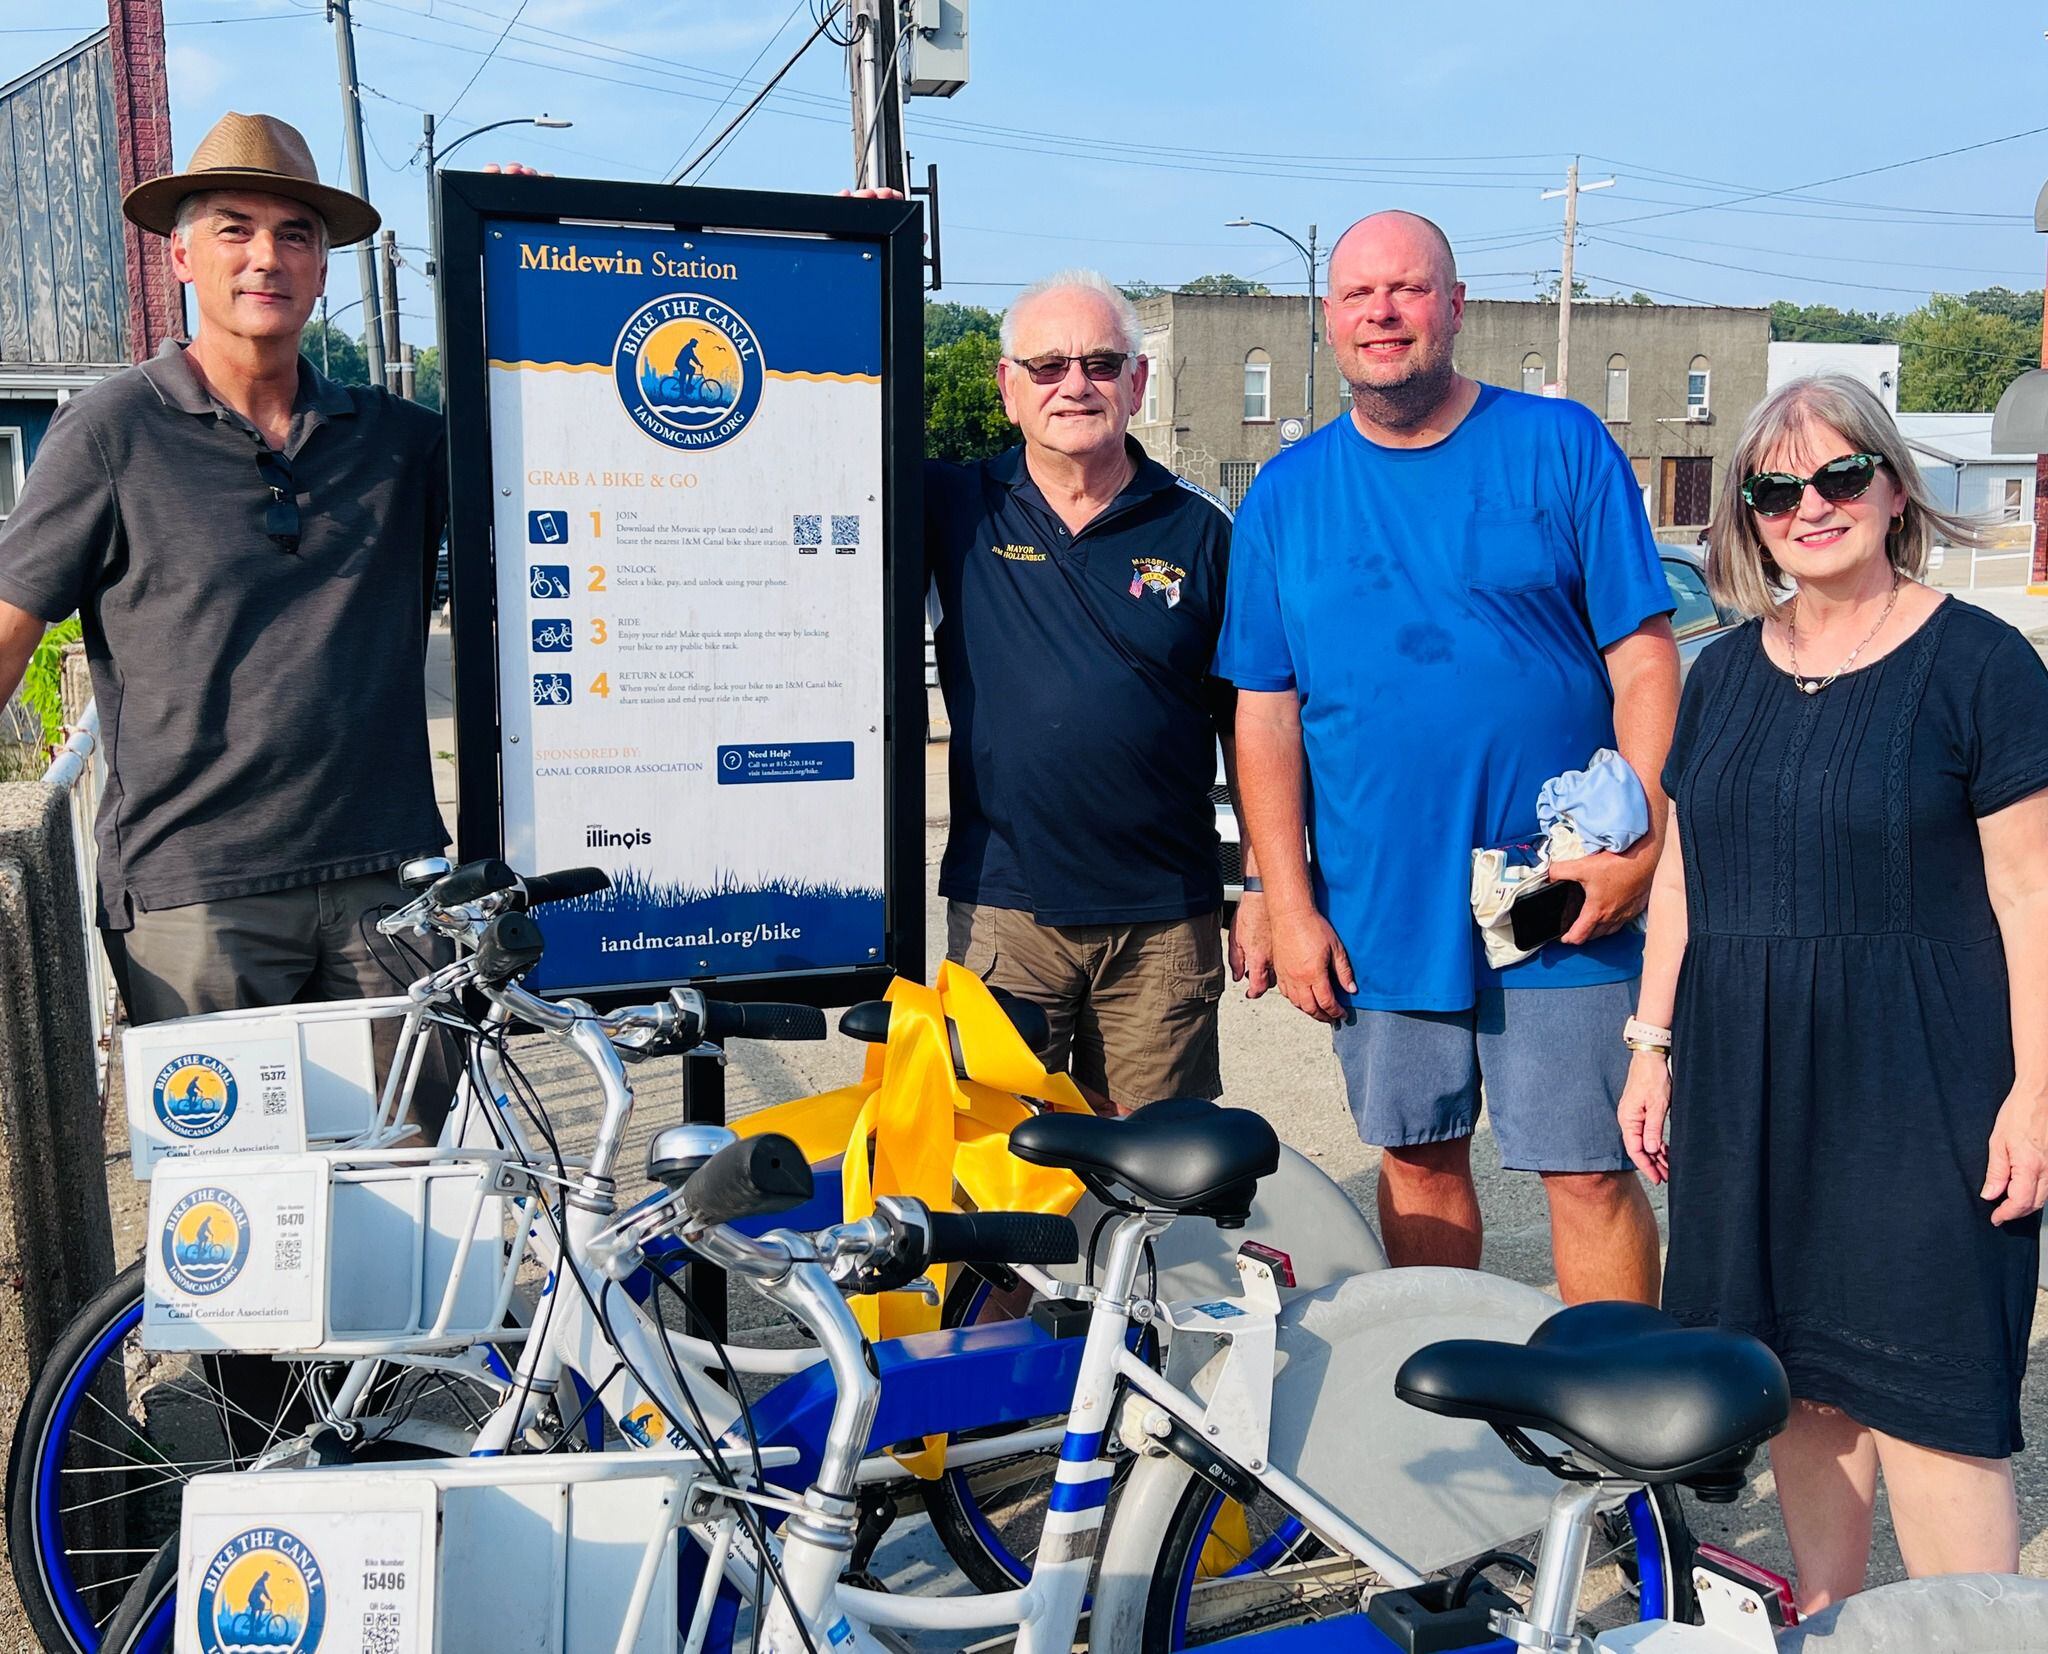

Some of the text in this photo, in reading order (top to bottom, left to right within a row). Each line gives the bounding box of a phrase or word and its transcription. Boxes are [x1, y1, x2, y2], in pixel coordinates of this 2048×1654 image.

[520, 244, 738, 280] Midewin Station
[622, 300, 756, 361] BIKE THE CANAL
[633, 404, 746, 445] IANDMCANAL.ORG
[528, 470, 698, 488] GRAB A BIKE & GO
[616, 512, 638, 520] JOIN
[590, 512, 602, 538] 1
[616, 524, 656, 533] Download
[658, 525, 668, 533] the
[702, 527, 716, 535] app
[760, 526, 773, 534] and
[654, 538, 680, 546] nearest
[682, 538, 701, 546] I&M
[703, 538, 724, 546] Canal
[726, 538, 742, 546] bike
[744, 538, 762, 546] share
[1007, 544, 1034, 554] MAYOR
[992, 546, 1046, 561] JIM HOLLENBECK
[616, 566, 656, 574] UNLOCK
[587, 566, 607, 592] 2
[617, 578, 638, 586] Select
[683, 578, 696, 586] and
[699, 578, 724, 586] unlock
[726, 579, 744, 588] using
[746, 580, 763, 588] your
[765, 578, 788, 587] phone.
[618, 618, 640, 626] RIDE
[590, 618, 608, 644] 3
[618, 631, 639, 640] Enjoy
[642, 632, 659, 640] your
[702, 630, 722, 640] quick
[724, 631, 742, 640] stops
[744, 630, 763, 639] along
[765, 630, 776, 638] the
[778, 631, 792, 639] way
[793, 630, 801, 639] by
[804, 629, 829, 639] locking
[618, 644, 635, 653] your
[638, 642, 654, 650] bike
[665, 644, 678, 652] any
[680, 642, 702, 652] public
[704, 642, 720, 650] bike
[619, 672, 657, 680] RETURN
[669, 671, 694, 679] LOCK
[590, 673, 610, 699] 4
[620, 684, 642, 692] When
[644, 684, 665, 693] you're
[667, 683, 686, 692] done
[714, 682, 728, 690] lock
[730, 684, 746, 692] your
[748, 682, 764, 690] bike
[786, 681, 804, 689] I&M
[806, 680, 826, 688] Canal
[828, 680, 842, 688] bike
[620, 696, 638, 704] share
[640, 696, 665, 704] station
[683, 695, 696, 703] end
[698, 696, 715, 704] your
[717, 694, 731, 702] ride
[742, 694, 753, 702] the
[536, 747, 641, 760] SPONSORED BY:
[748, 750, 791, 759] Need Help?
[536, 762, 703, 777] CANAL CORRIDOR ASSOCIATION
[587, 828, 652, 850] illinois
[602, 922, 801, 952] iandmcanal.org/bike
[156, 1055, 233, 1091] BIKE THE CANAL
[261, 1070, 286, 1081] 15372
[163, 1114, 229, 1137] IANDMCANAL.ORG
[166, 1144, 280, 1158] Canal Corridor Association
[166, 1190, 245, 1232] BIKE THE CANAL
[277, 1213, 304, 1226] 16470
[169, 1266, 238, 1292] IANDMCANAL.ORG
[168, 1303, 289, 1318] Canal Corridor Association
[204, 1532, 322, 1593] BIKE THE CANAL
[362, 1572, 405, 1590] 15496
